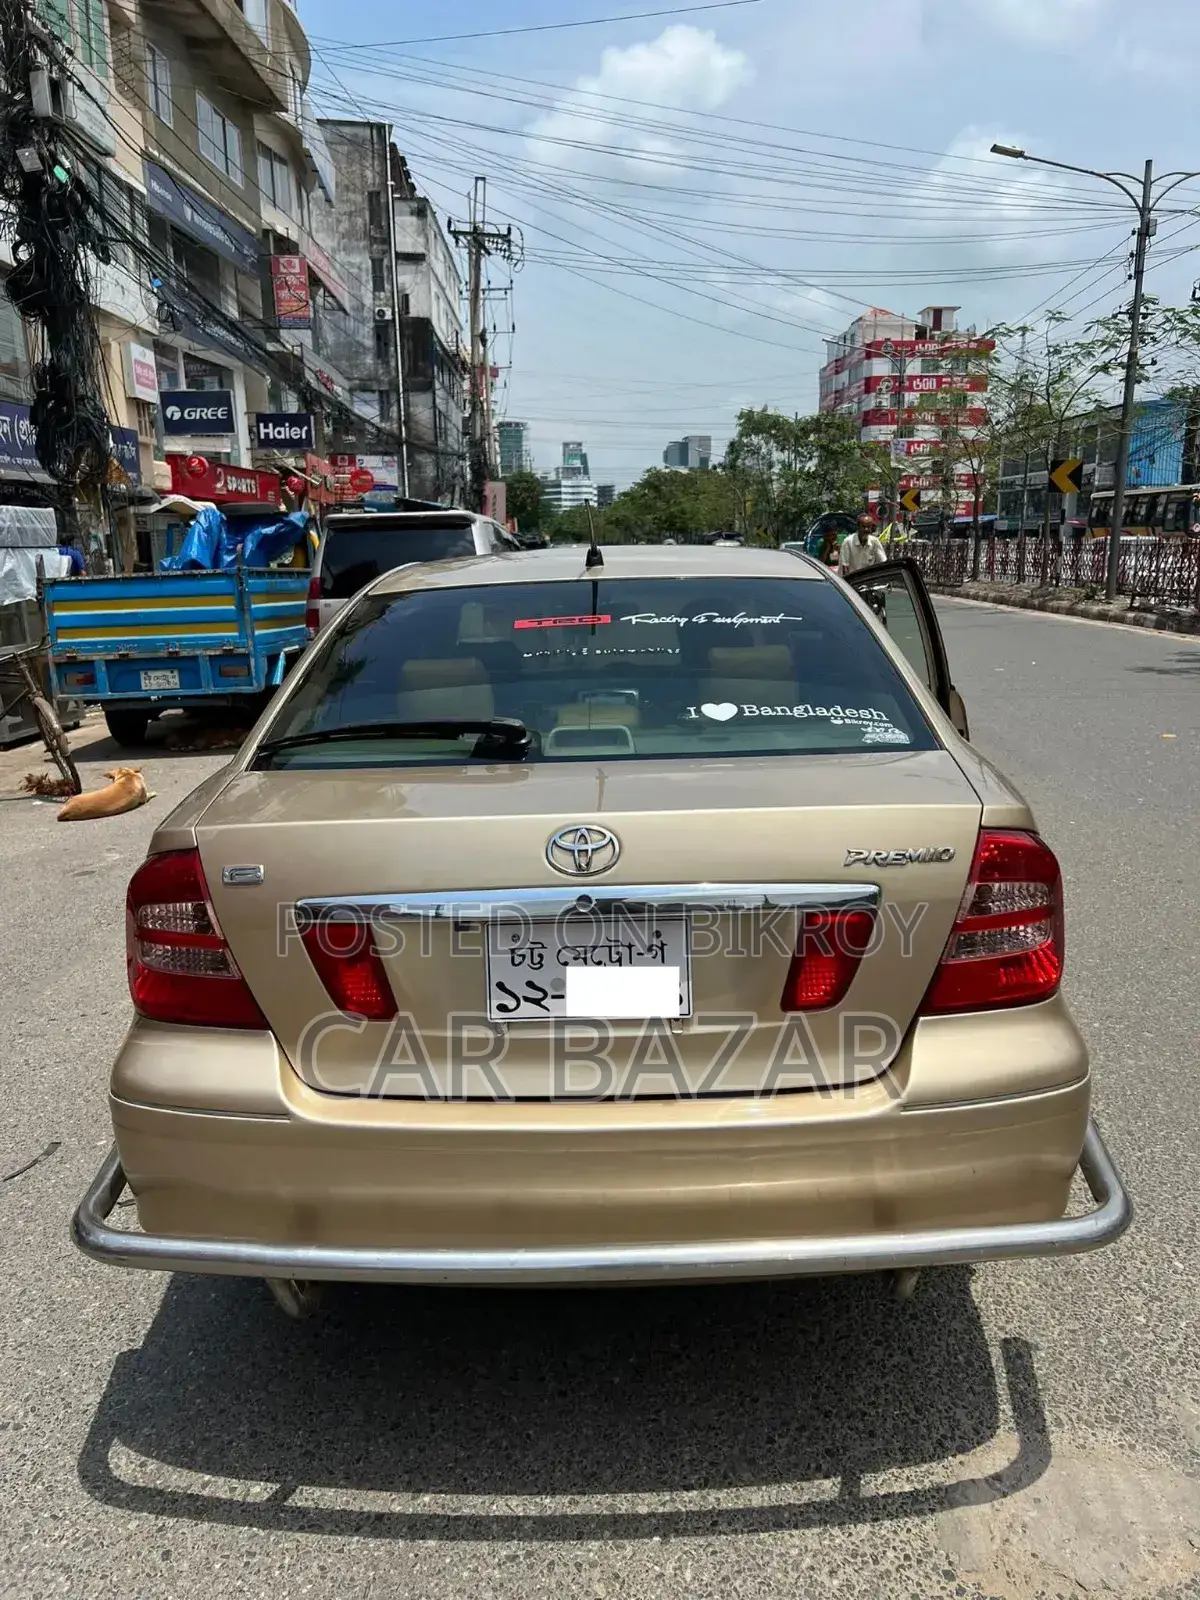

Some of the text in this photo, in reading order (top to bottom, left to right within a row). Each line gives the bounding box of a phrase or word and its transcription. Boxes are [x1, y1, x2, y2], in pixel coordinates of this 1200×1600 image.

[184, 406, 229, 420] GREE
[259, 422, 308, 440] Haier
[620, 613, 689, 627] Racing
[686, 704, 890, 722] I Bangladesh
[844, 718, 894, 729] Bikroy.com
[843, 846, 956, 868] PREMIO
